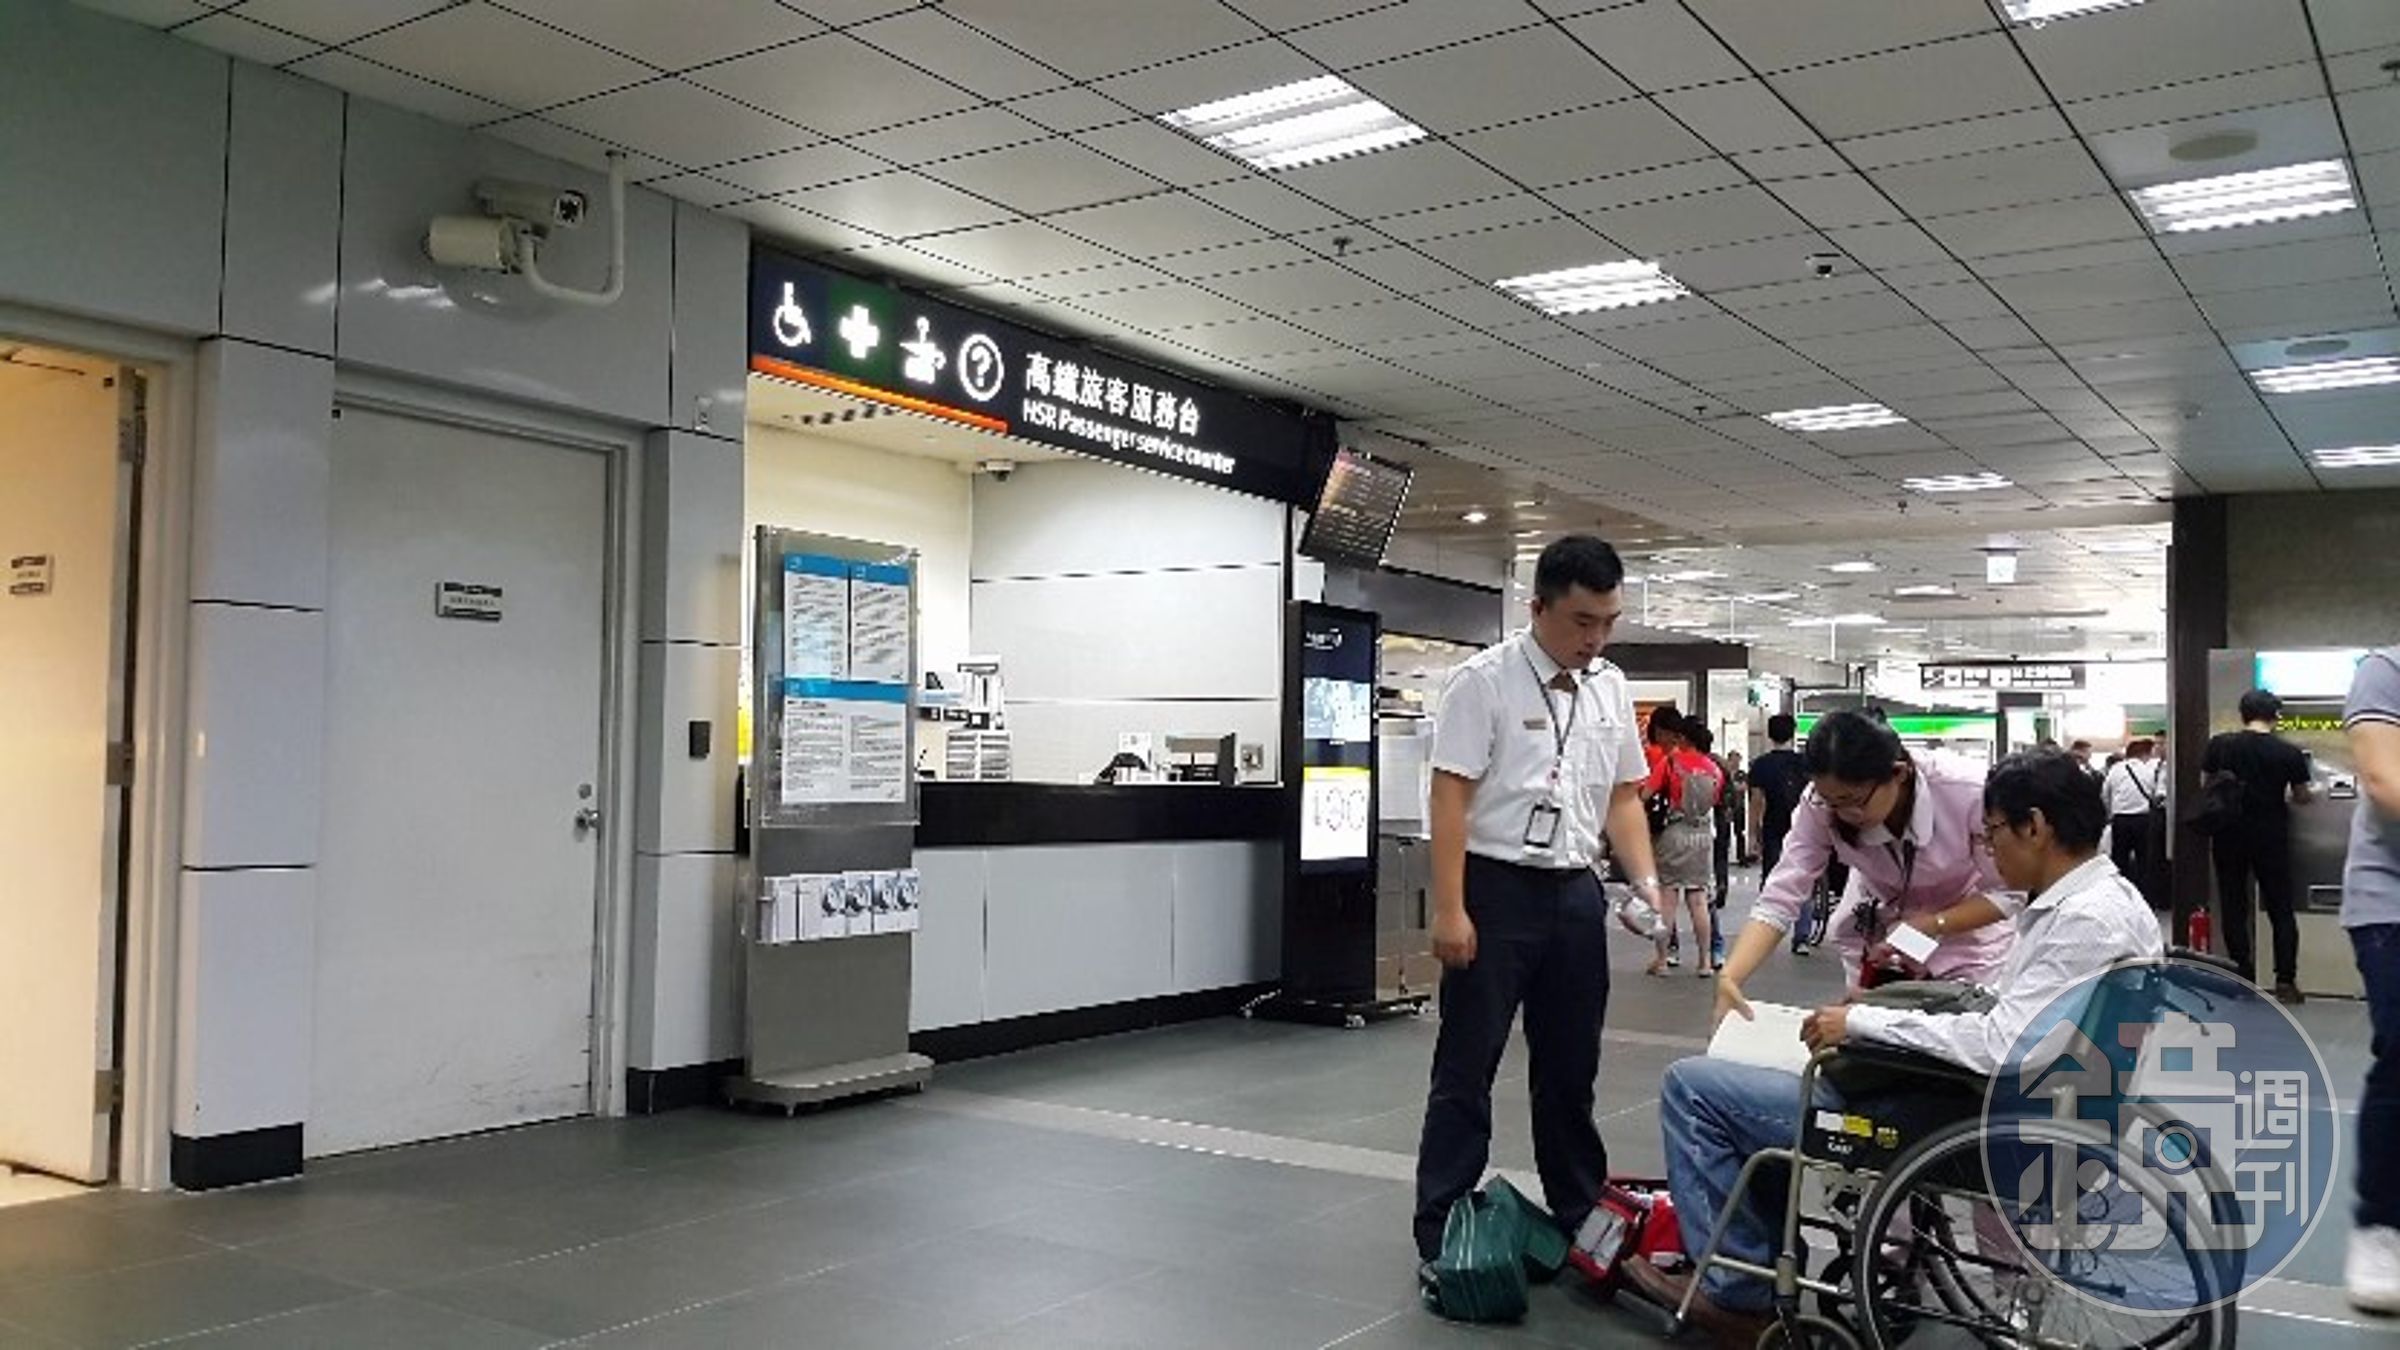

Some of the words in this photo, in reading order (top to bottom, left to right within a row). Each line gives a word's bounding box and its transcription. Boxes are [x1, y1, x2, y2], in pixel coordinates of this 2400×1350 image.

[1022, 397, 1057, 431] HSR
[1058, 408, 1136, 451] Passenger
[1136, 434, 1184, 463] service
[1025, 351, 1200, 436] 高鐵旅客服務台
